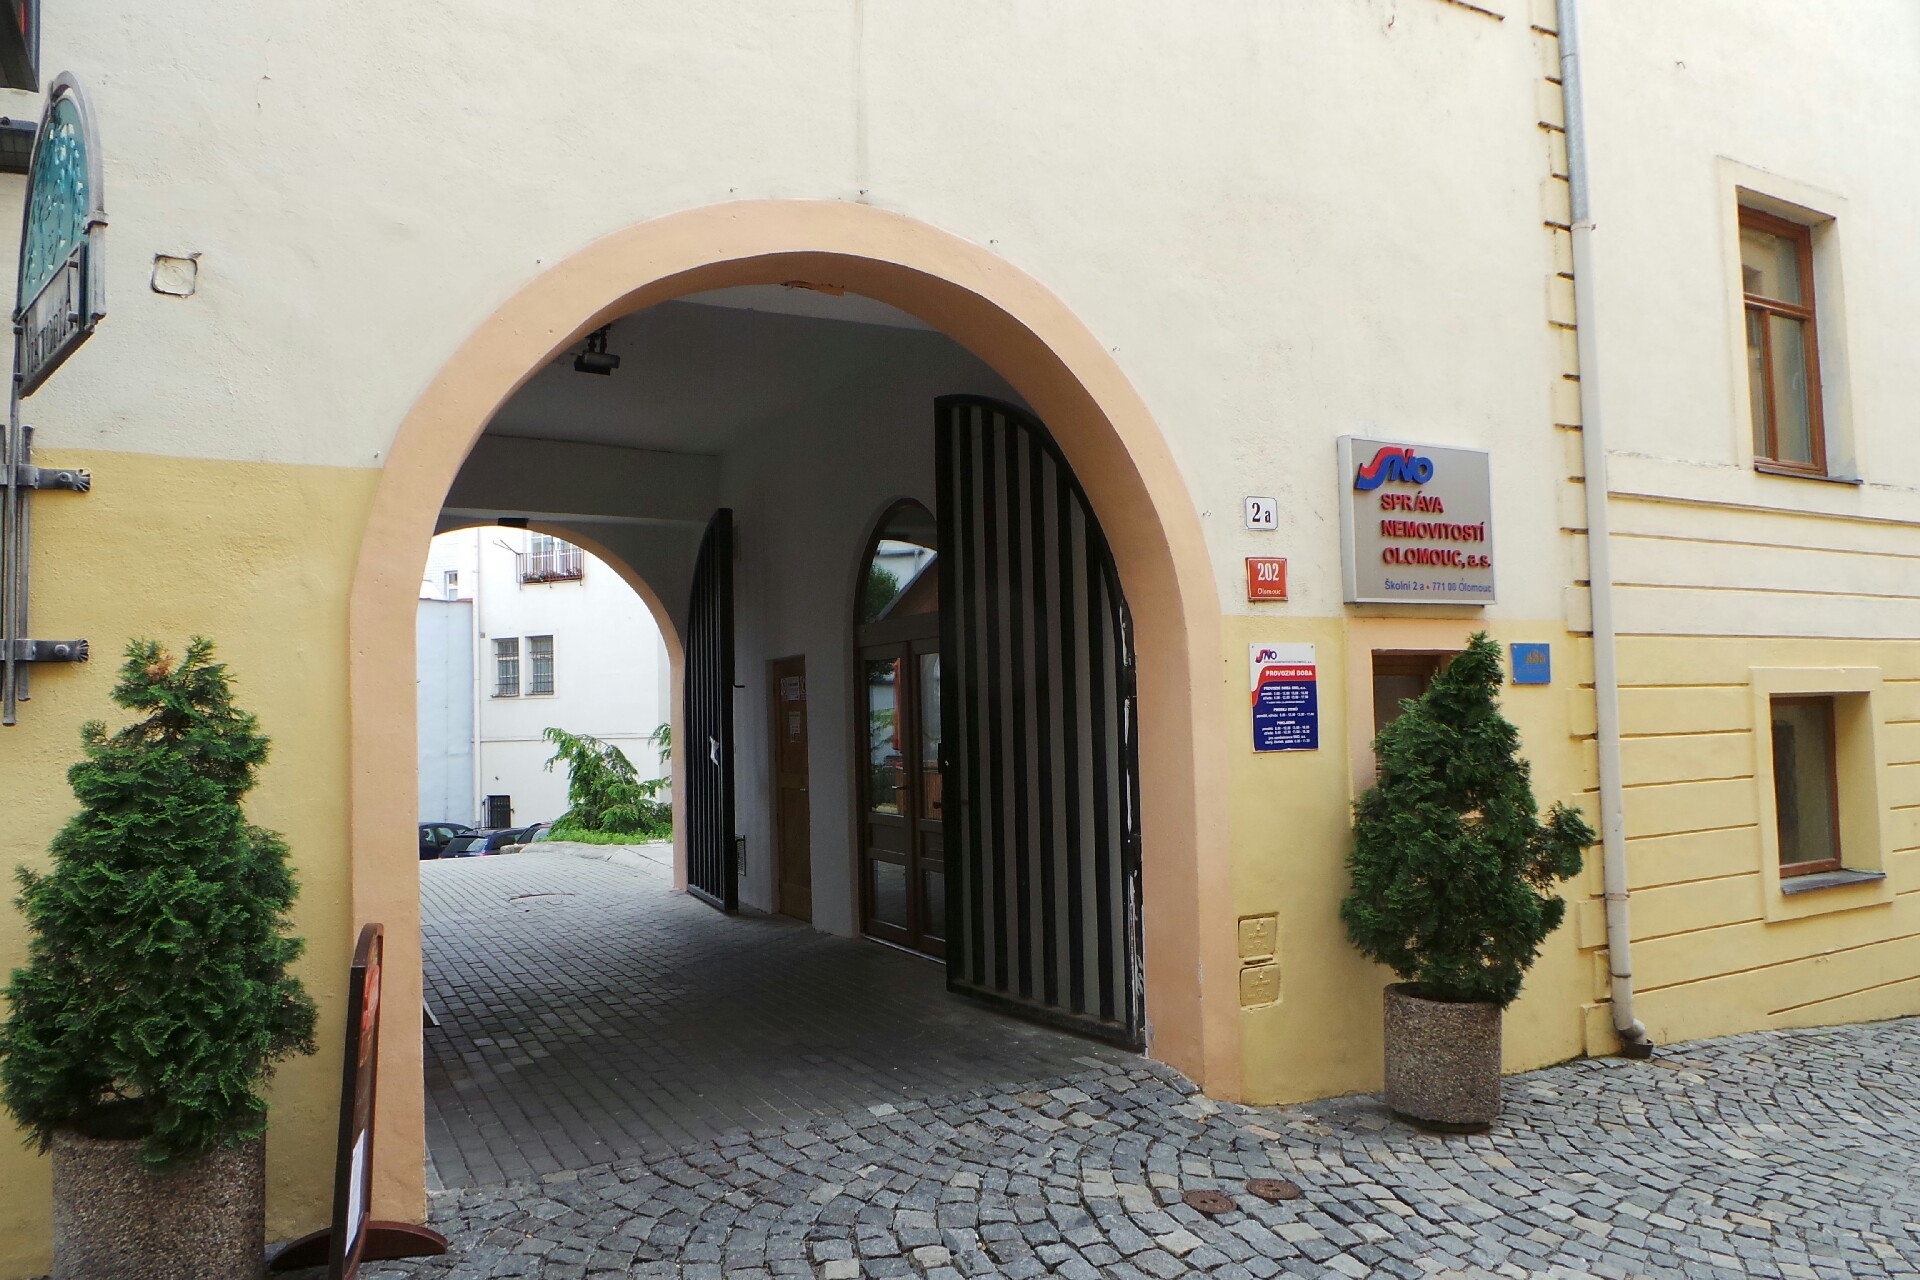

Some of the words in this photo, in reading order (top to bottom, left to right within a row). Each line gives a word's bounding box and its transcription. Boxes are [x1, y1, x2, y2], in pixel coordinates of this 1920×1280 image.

[1355, 446, 1434, 490] SNO
[1252, 502, 1261, 523] 2
[1264, 510, 1271, 523] a
[1381, 491, 1444, 513] SPRÁVA
[1381, 520, 1485, 542] NEMOVITOSTÍ
[1383, 547, 1466, 569] OLOMOUC,
[1258, 563, 1279, 581] 202
[1412, 581, 1418, 591] 2
[1419, 583, 1425, 591] a
[1432, 581, 1445, 591] 771
